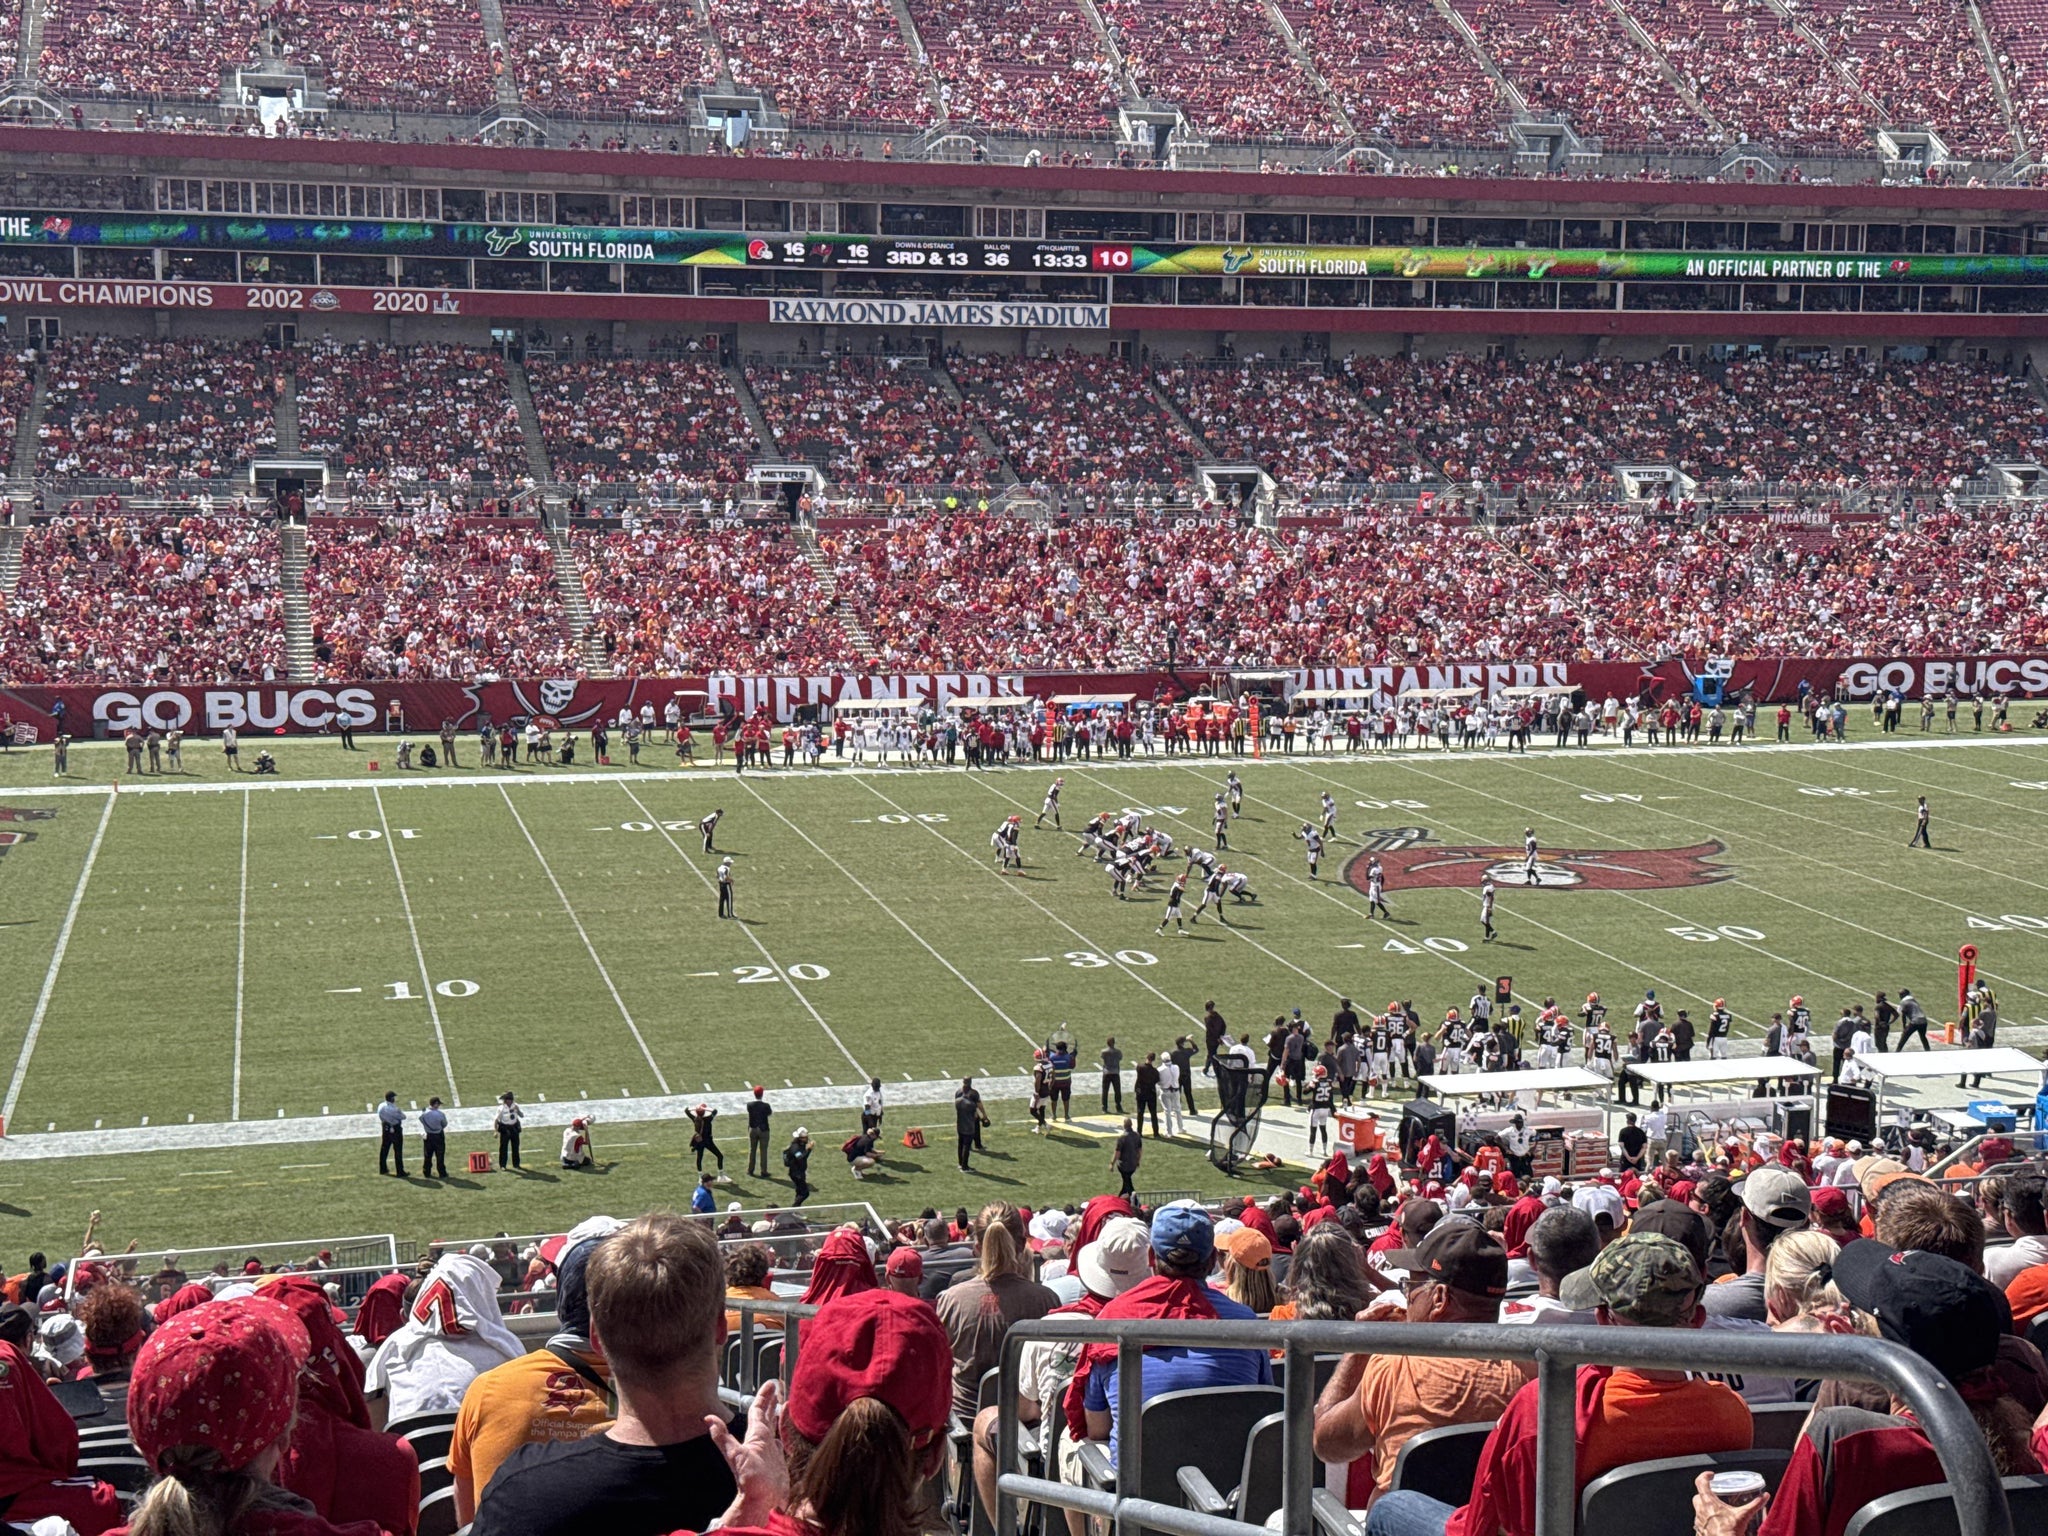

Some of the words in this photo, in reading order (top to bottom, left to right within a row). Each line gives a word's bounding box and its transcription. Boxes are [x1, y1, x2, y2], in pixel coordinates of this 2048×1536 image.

[0, 217, 31, 237] THE
[529, 231, 582, 239] UNIVERSITY
[528, 241, 583, 258] SOUTH
[588, 242, 655, 260] FLORIDA
[783, 242, 805, 256] 16
[847, 244, 869, 259] 16
[1259, 249, 1304, 257] UNIVERSITY
[886, 250, 925, 265] 3RD
[929, 252, 943, 265] &
[948, 253, 968, 266] 13
[984, 253, 1010, 267] 36
[1032, 254, 1087, 268] 13:33
[1100, 251, 1128, 266] 10
[1258, 258, 1305, 274] SOUTH
[1310, 259, 1367, 275] FLORIDA
[1686, 259, 1704, 276] AN
[1708, 259, 1769, 277] OFFICIAL
[1772, 260, 1832, 278] PARTNER
[1837, 261, 1853, 278] OF
[1858, 261, 1881, 278] THE
[59, 283, 213, 307] CHAMPIONS
[247, 288, 303, 309] 2002
[373, 292, 428, 312] 2020
[772, 300, 906, 323] RAYMOND
[909, 302, 994, 325] JAMES
[1000, 305, 1108, 328] STADIUM
[760, 470, 806, 479] METERS
[708, 518, 745, 529] 1976
[1174, 518, 1195, 528] GO
[1768, 512, 1831, 524] BUCCANEERS
[1846, 661, 1915, 696] GO
[1924, 659, 2048, 694] BUCS
[93, 691, 192, 731] GO
[205, 688, 377, 729] BUCS
[1966, 914, 2048, 931] 40
[1664, 925, 1766, 942] 50
[1382, 937, 1469, 955] 40
[1063, 949, 1160, 968] 30
[732, 963, 831, 984] 20
[384, 979, 481, 1000] 10
[1499, 979, 1510, 994] 3
[1388, 1021, 1405, 1035] 86
[1595, 1038, 1612, 1053] 34
[911, 1131, 924, 1146] 20
[1341, 1122, 1356, 1140] G
[472, 1154, 486, 1170] 10
[1488, 1159, 1497, 1174] 6
[532, 1418, 565, 1429] Official
[531, 1428, 546, 1437] the
[548, 1428, 578, 1440] Tampa
